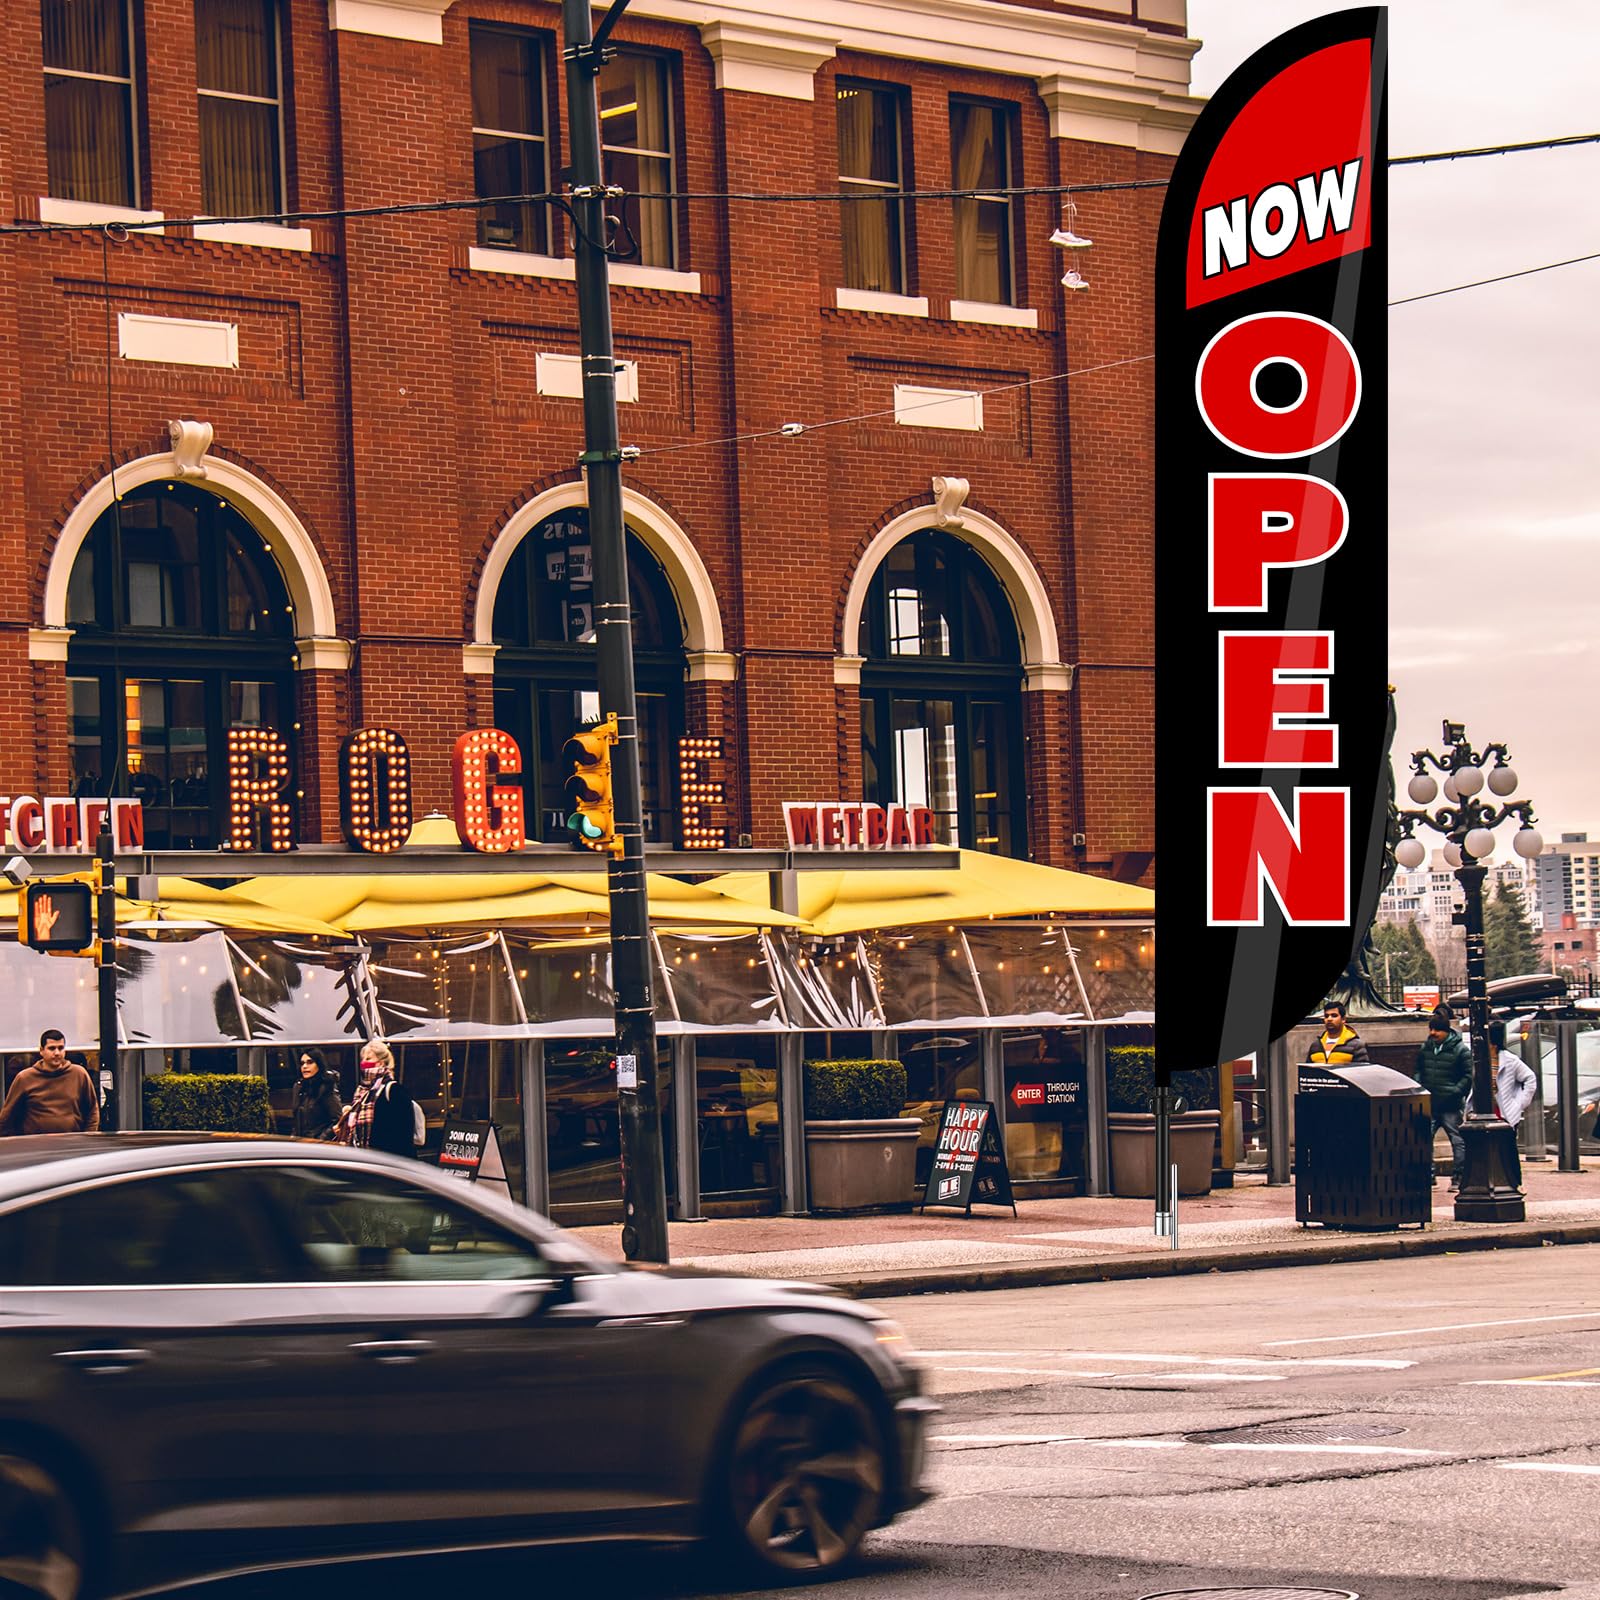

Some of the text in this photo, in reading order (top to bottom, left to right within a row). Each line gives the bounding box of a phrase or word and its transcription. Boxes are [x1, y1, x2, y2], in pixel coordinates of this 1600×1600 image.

[1203, 158, 1362, 278] NOW
[1195, 311, 1362, 927] OPEN
[227, 727, 727, 853] ROGE
[1017, 1089, 1041, 1099] ENTER
[1047, 1082, 1080, 1092] THROUGH
[1047, 1094, 1075, 1104] STATION
[945, 1108, 988, 1129] HAPPY
[449, 1130, 479, 1143] JOIN OUR
[940, 1128, 980, 1152] HOUR
